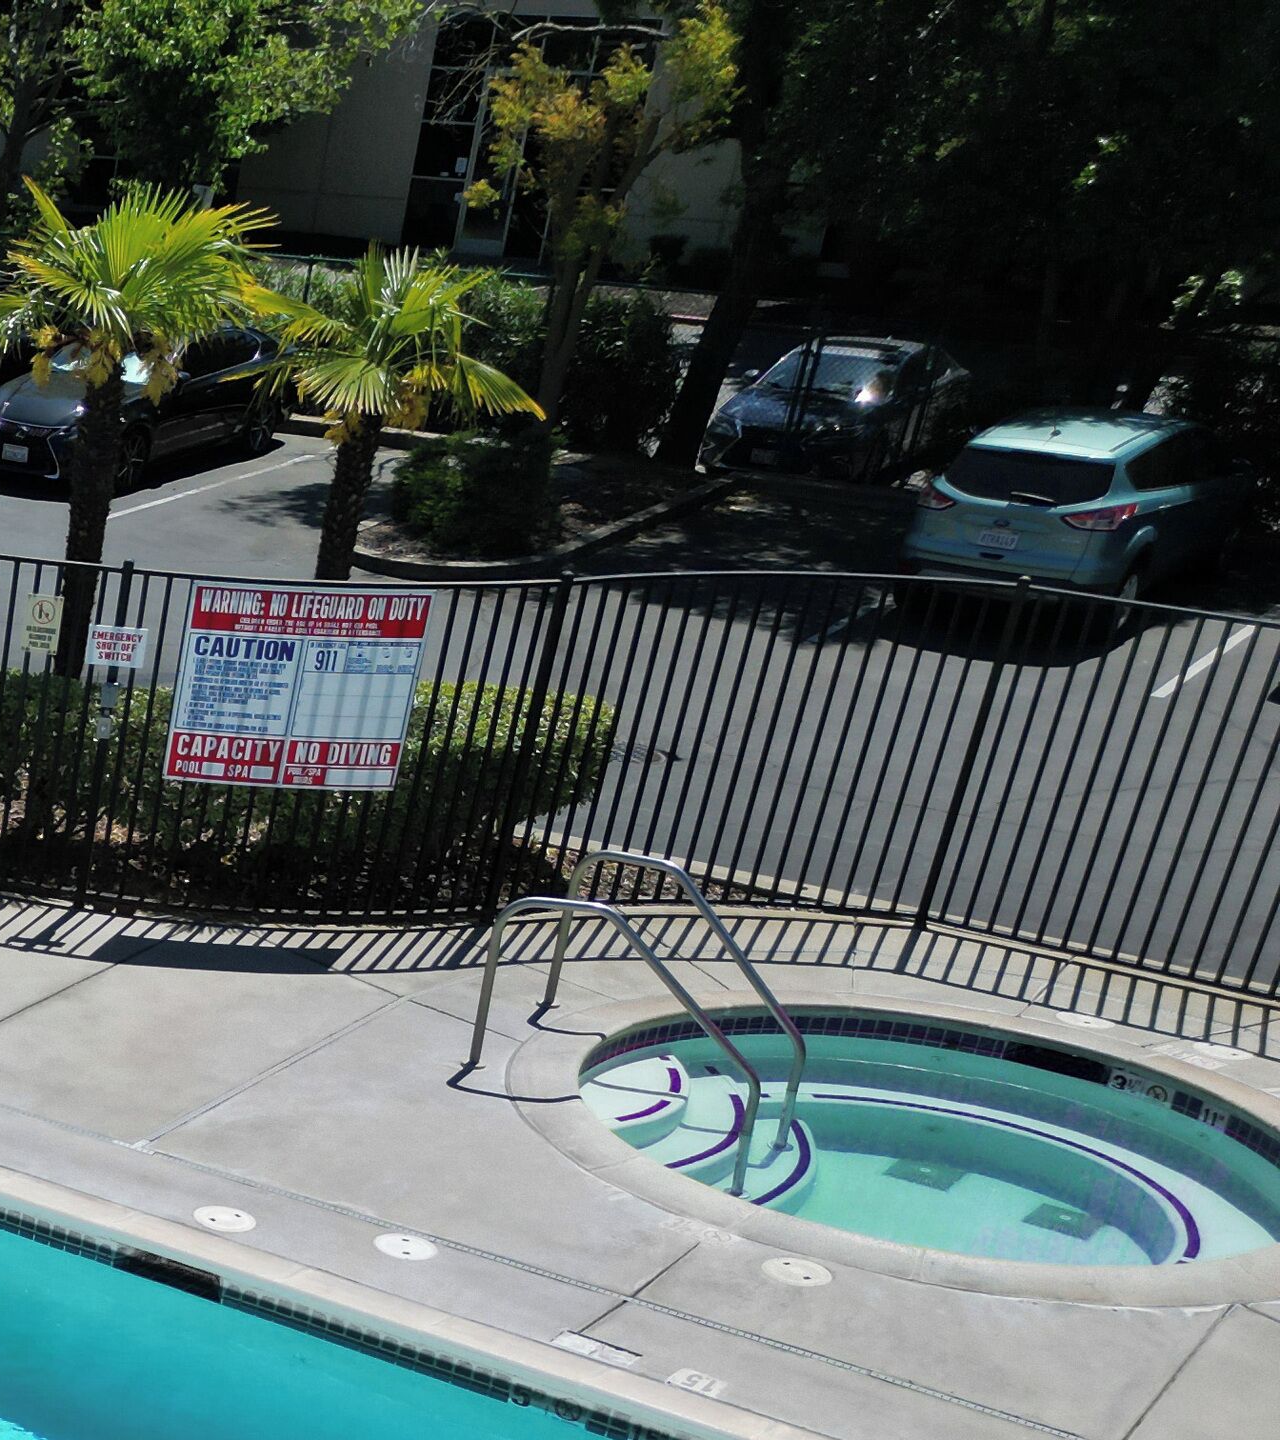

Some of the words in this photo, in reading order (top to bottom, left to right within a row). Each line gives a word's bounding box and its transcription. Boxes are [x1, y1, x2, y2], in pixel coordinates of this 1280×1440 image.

[200, 588, 265, 616] WARNING:
[269, 593, 288, 617] NO
[291, 594, 364, 620] LIFEGUARD
[368, 598, 385, 621] ON
[389, 597, 426, 621] DUTY
[92, 631, 143, 643] EMERGENCY
[96, 641, 117, 651] SHUT
[121, 643, 137, 652] OFF
[98, 651, 132, 662] SWITCH
[194, 635, 295, 662] CAUTION
[314, 650, 337, 672] 911
[176, 735, 281, 762] CAPACITY
[294, 742, 320, 763] NO
[327, 743, 392, 765] DIVING
[175, 760, 201, 775] POOL
[227, 764, 248, 778] SPA
